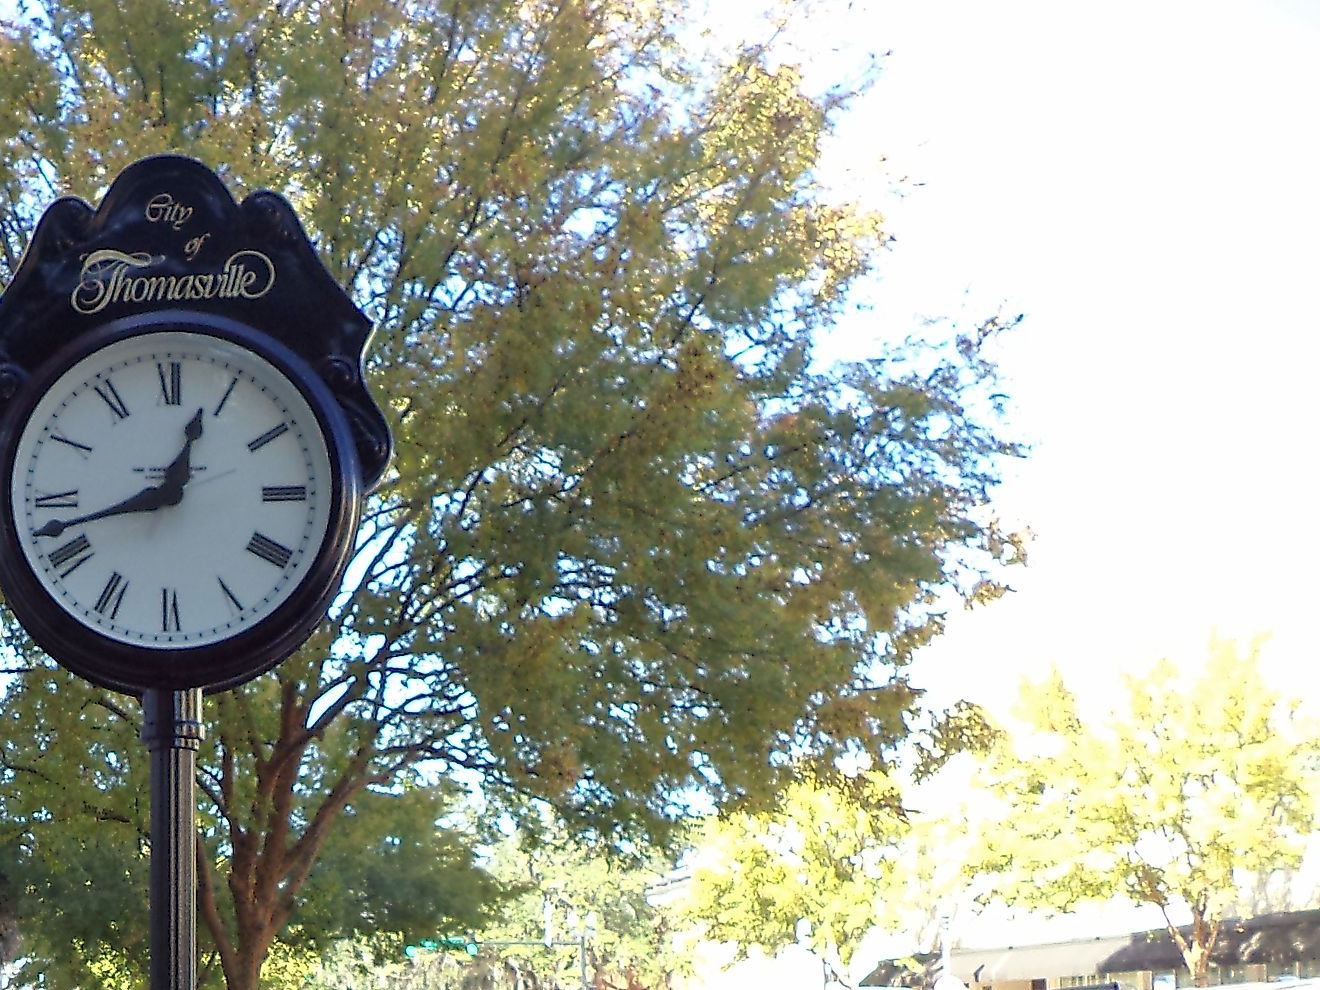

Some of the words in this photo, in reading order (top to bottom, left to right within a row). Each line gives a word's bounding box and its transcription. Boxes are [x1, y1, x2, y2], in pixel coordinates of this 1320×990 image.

[145, 193, 194, 230] City
[184, 232, 211, 262] of
[70, 249, 276, 315] Thomasville
